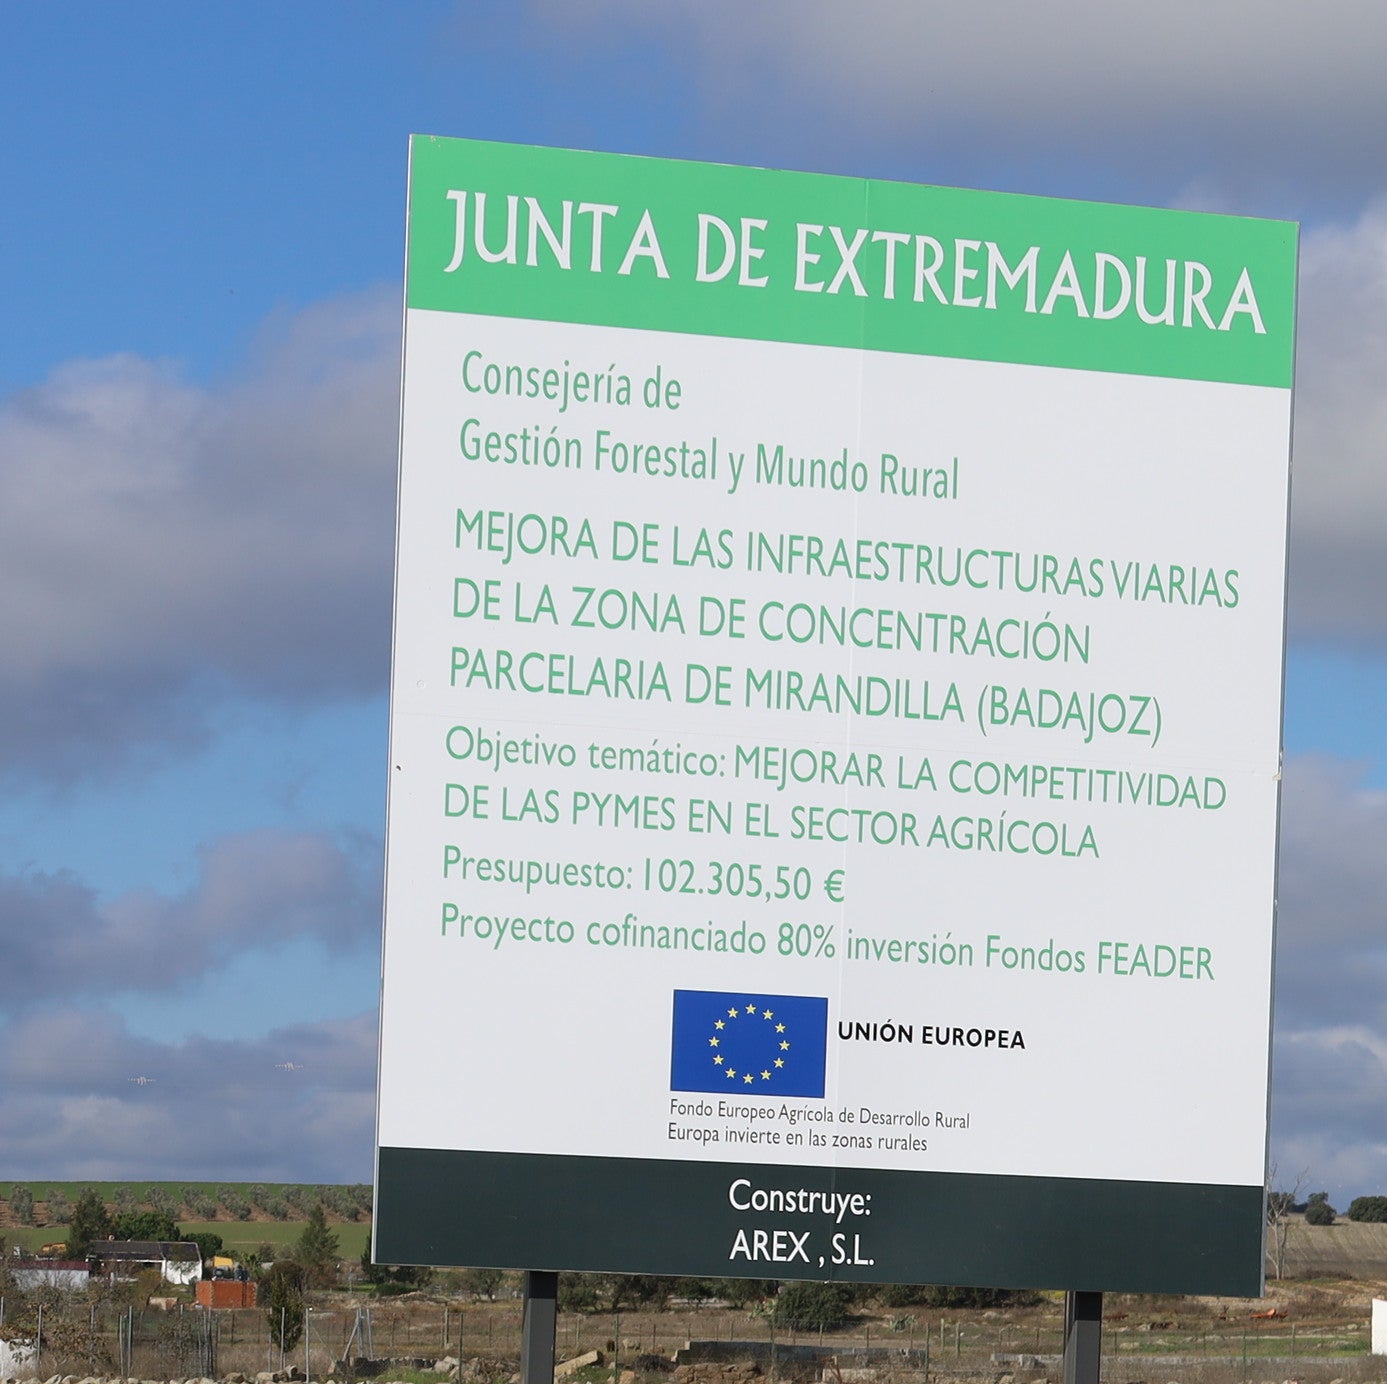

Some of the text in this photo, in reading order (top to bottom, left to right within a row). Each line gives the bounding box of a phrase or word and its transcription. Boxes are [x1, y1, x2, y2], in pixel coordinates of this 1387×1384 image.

[444, 189, 1267, 334] JUNTA DE EXTREMADURA
[462, 349, 683, 414] Consejería de
[459, 417, 959, 499] Gestión Forestal y Mundo Rural
[455, 508, 1240, 609] MEJORA DE LAS INFRAESTRUCTURAS VIARIAS
[452, 577, 1090, 664] DE LA ZONA DE CONCENTRACIÓN
[450, 646, 1162, 749] PARCELARIA DE MIRANDILLA (BADAJOZ)
[445, 725, 1227, 810] Objetivo temático: MEJORAR LA COMPETITIVIDAD
[444, 783, 1099, 858] DE LAS PYMES EN EL SECTOR AGRÍCOLA
[443, 844, 846, 903] Presupuesto: 102.305,50 €
[442, 902, 1214, 980] Proyecto cofinanciado 80% inversión Fondos FEADER
[838, 1018, 1026, 1050] UNIÓN EUROPEA
[668, 1122, 928, 1151] Europa invierte en las zonas rurales
[670, 1098, 970, 1129] Fondo Europeo Agrícola de Desarrollo Rural
[729, 1178, 871, 1224] Construye:
[729, 1229, 811, 1263] AREX
